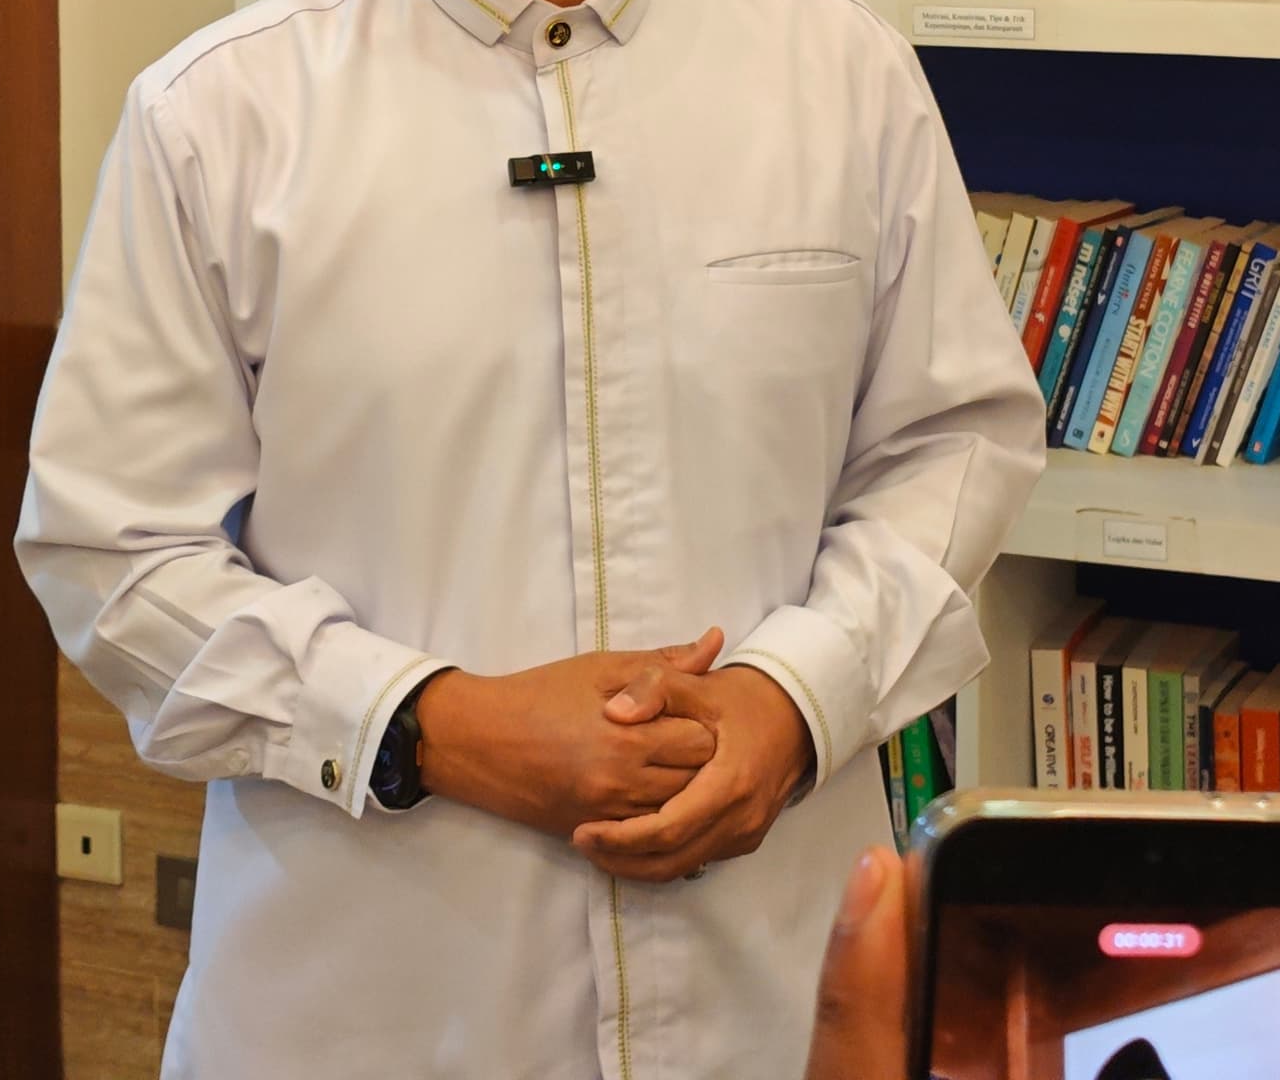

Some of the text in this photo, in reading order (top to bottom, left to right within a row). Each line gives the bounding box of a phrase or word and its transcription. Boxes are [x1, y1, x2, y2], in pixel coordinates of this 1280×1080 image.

[1138, 246, 1196, 379] FEARNE COTTON
[1099, 315, 1146, 420] START WITH WHY
[1103, 674, 1113, 700] How
[1044, 724, 1057, 776] CREATIVE
[1114, 932, 1184, 948] 00:00:31
